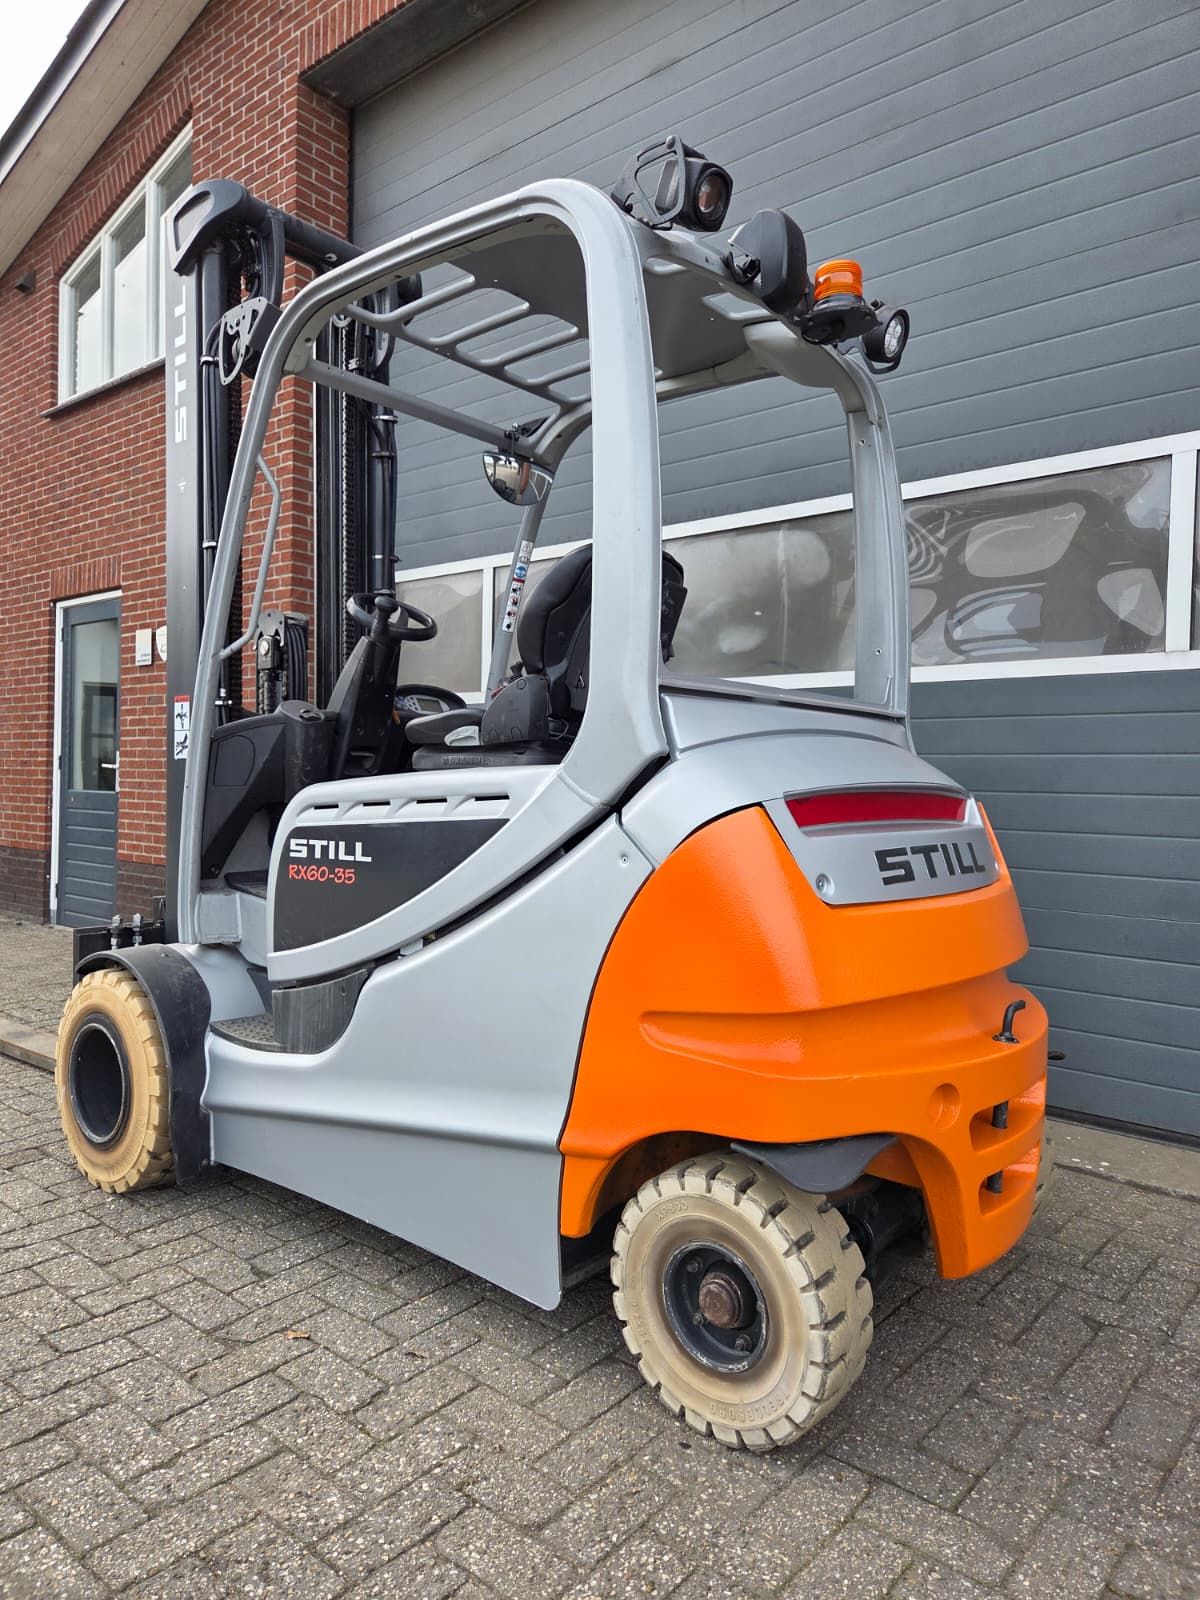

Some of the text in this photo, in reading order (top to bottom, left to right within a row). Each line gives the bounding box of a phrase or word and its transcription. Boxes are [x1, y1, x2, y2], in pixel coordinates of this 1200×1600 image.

[174, 283, 188, 444] STILL
[289, 838, 372, 862] STILL
[874, 842, 986, 886] STILL
[288, 863, 356, 885] RX60-35
